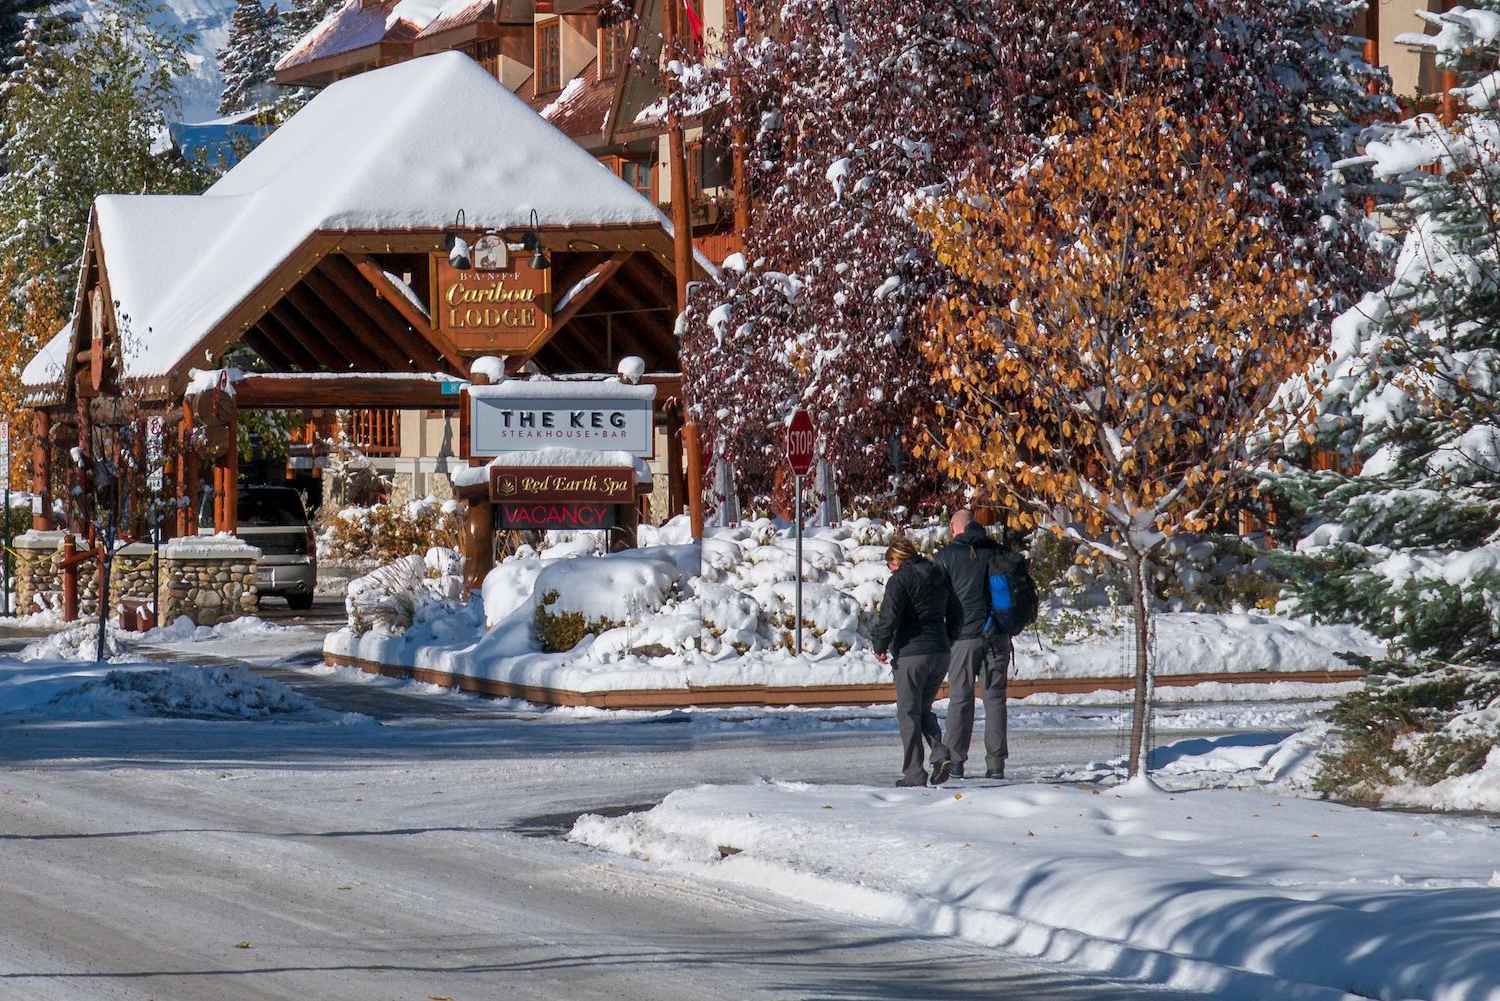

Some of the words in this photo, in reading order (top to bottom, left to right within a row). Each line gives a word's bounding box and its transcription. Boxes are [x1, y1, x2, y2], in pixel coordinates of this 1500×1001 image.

[446, 281, 535, 306] Caribou
[449, 308, 536, 328] LODGE
[501, 411, 555, 428] THE
[570, 411, 626, 429] KEG
[501, 430, 590, 438] STEAKHOUSE
[602, 430, 627, 438] BAR
[790, 431, 812, 455] STOP
[521, 475, 553, 494] Red
[553, 475, 597, 491] Earth
[599, 477, 628, 496] Spa
[505, 506, 606, 524] VACANCY
